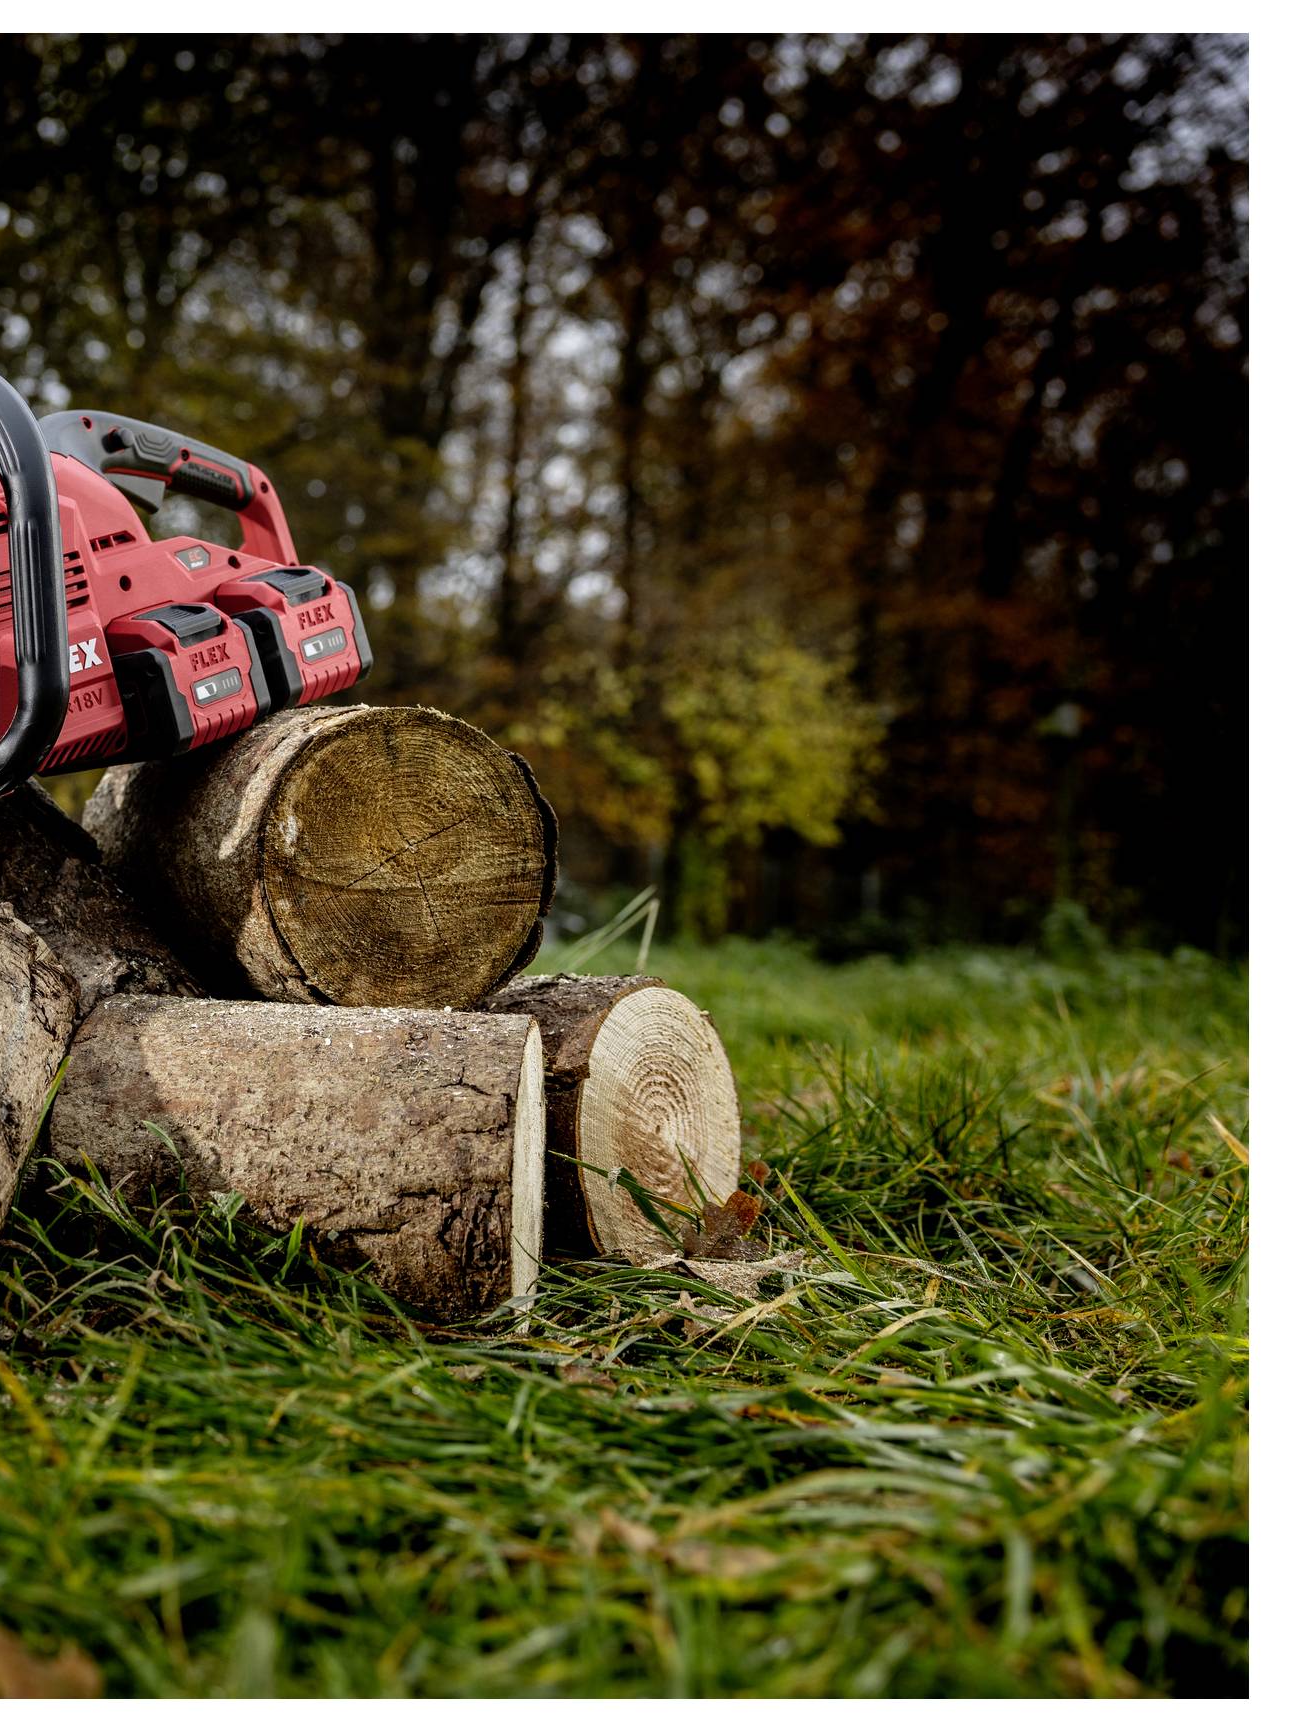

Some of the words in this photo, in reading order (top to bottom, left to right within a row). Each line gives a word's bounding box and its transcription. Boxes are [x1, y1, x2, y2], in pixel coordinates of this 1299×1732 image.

[297, 603, 335, 630] FLEX
[69, 638, 104, 674] EX
[189, 642, 231, 672] FLEX
